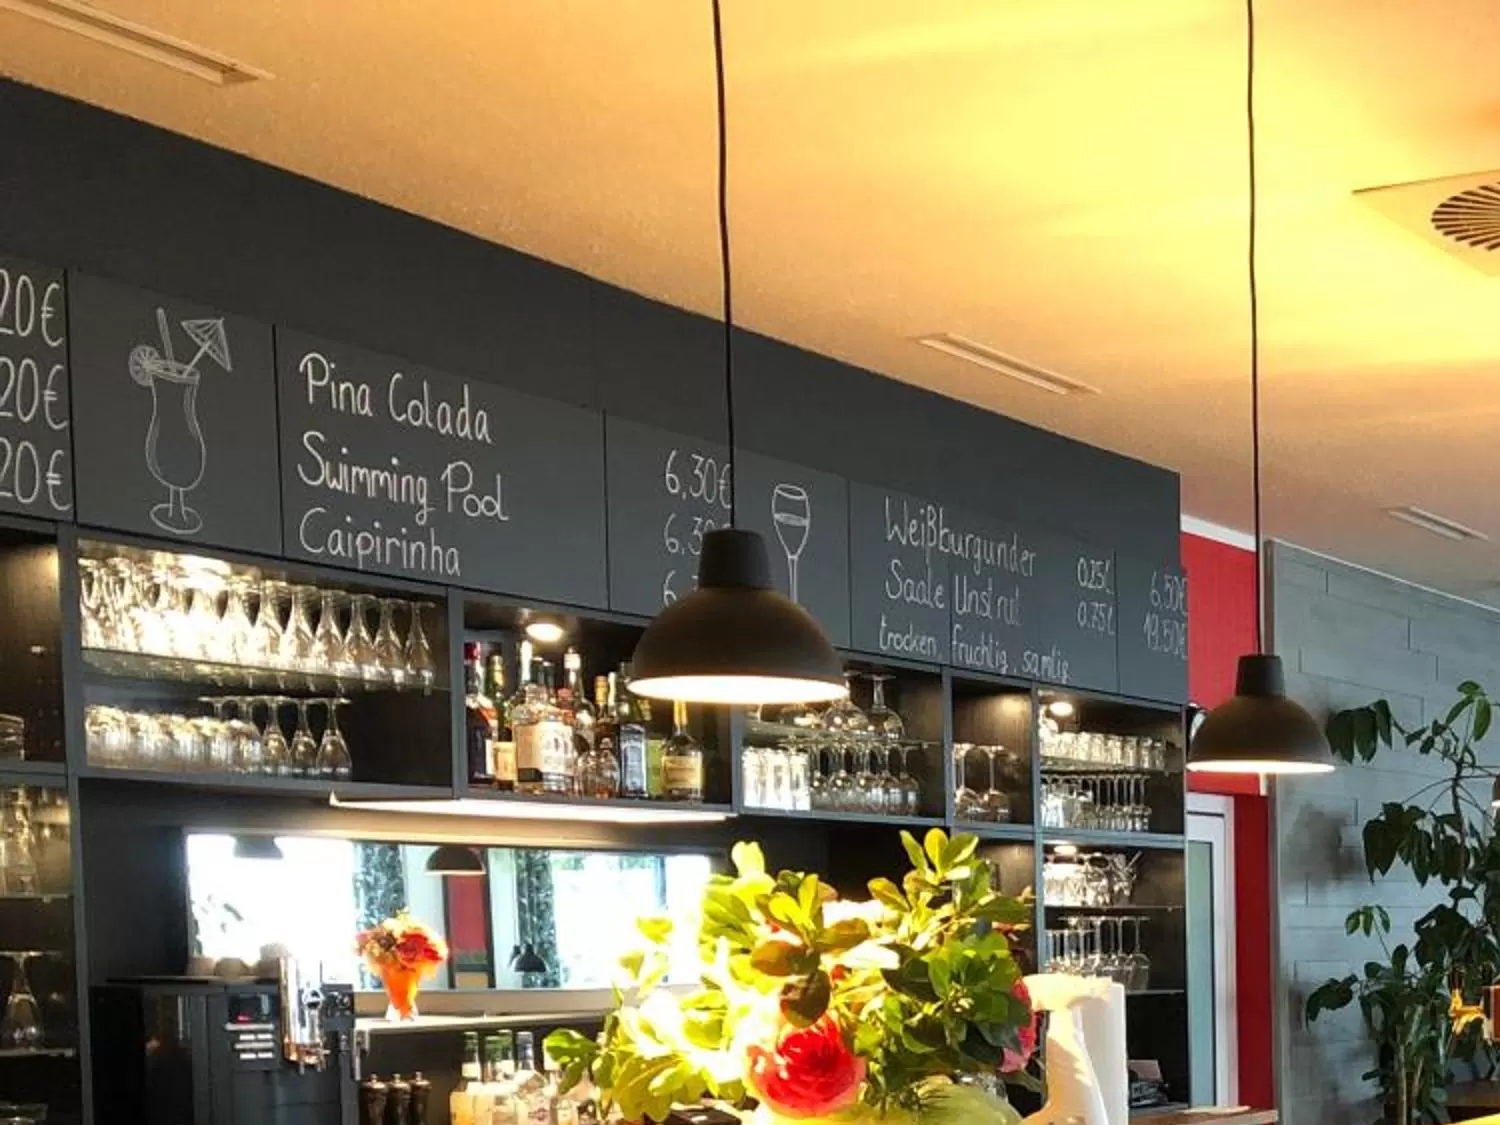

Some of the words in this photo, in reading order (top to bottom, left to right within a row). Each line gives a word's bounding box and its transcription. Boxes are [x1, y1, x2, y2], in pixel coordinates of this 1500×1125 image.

[299, 352, 373, 417] Pina
[388, 372, 494, 444] Colada
[297, 430, 436, 525] Swimming
[440, 460, 510, 521] Pool
[299, 507, 461, 577] Caipirinha
[885, 558, 945, 609] Saale
